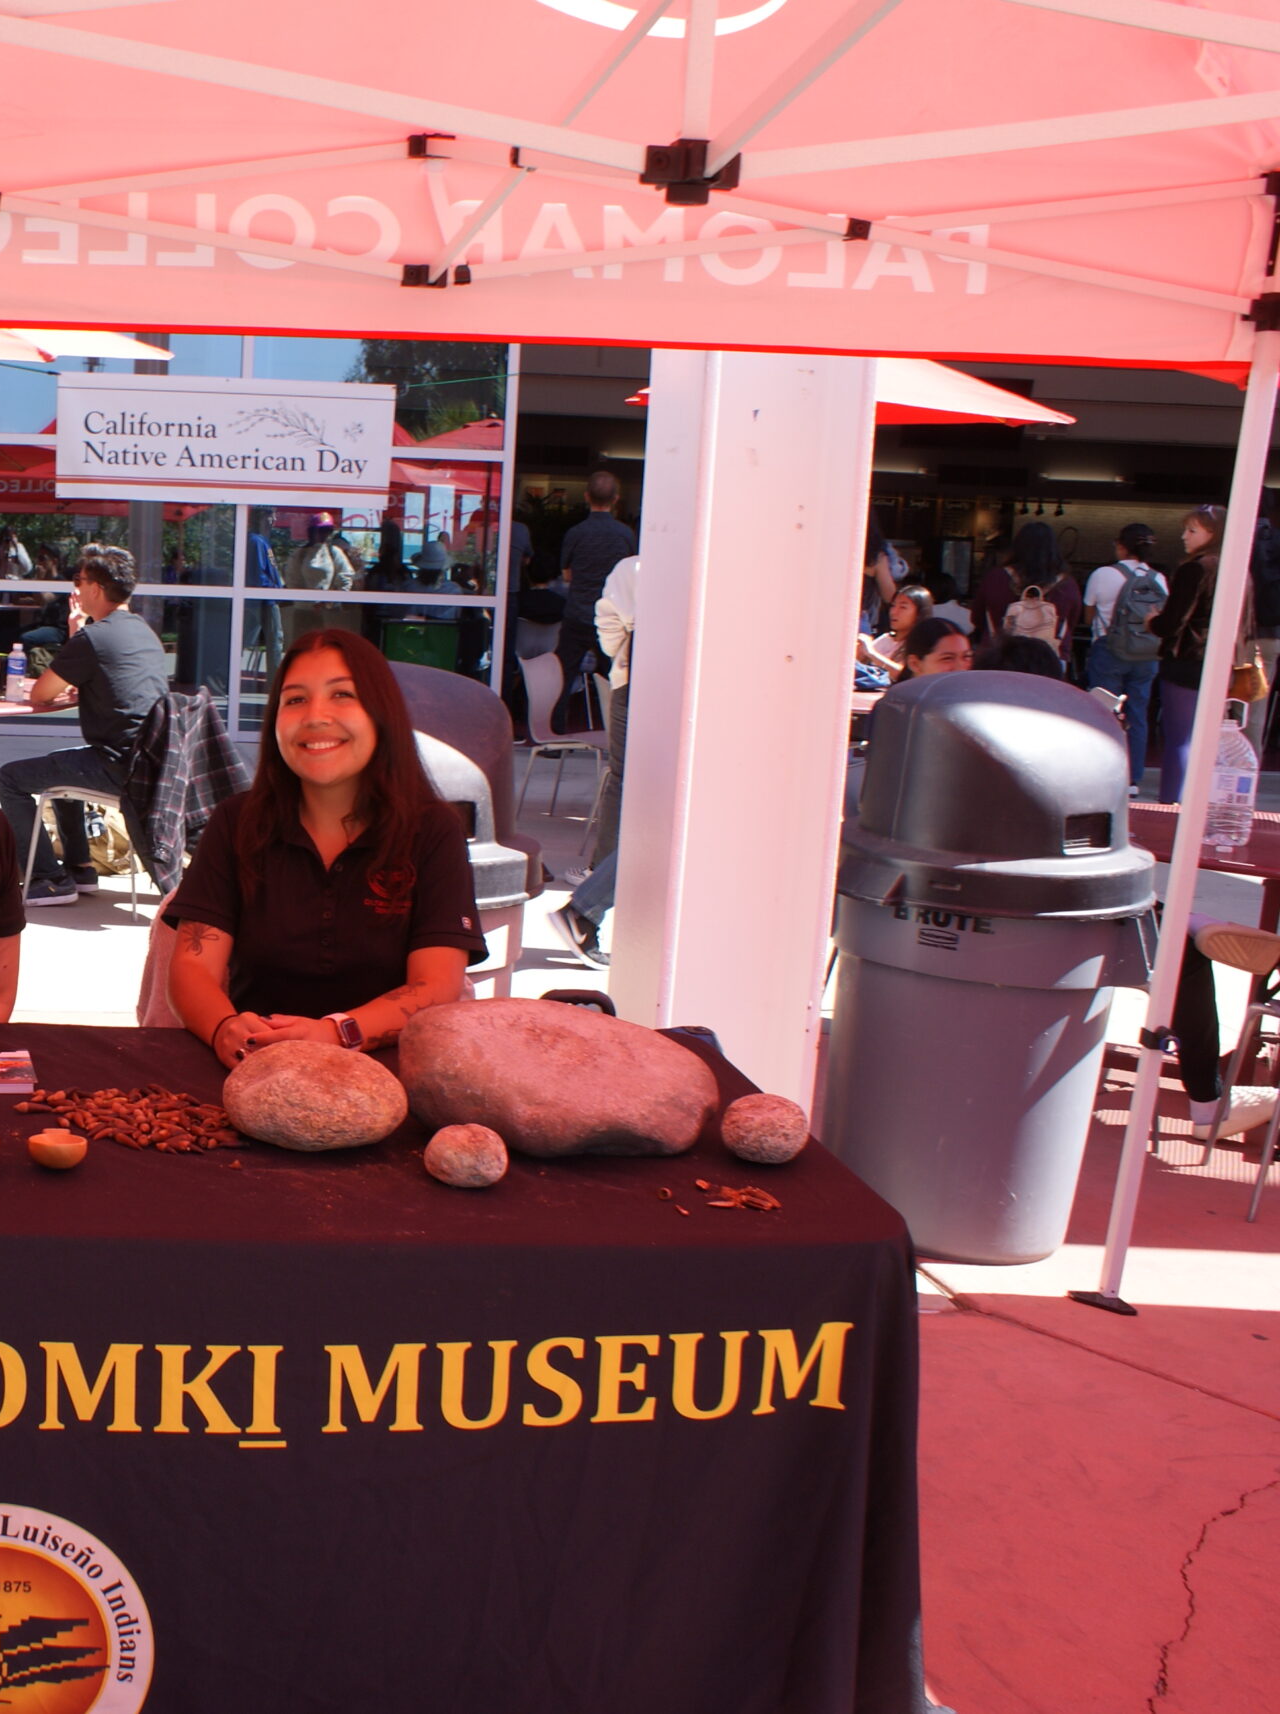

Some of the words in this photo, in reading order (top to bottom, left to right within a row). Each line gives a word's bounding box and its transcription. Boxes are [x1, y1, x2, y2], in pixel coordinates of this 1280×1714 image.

[82, 440, 168, 467] Native
[175, 444, 306, 472] American
[316, 449, 369, 479] Day
[83, 410, 218, 439] California
[321, 1321, 854, 1432] MUSEUM
[0, 1514, 104, 1580] Luiseño
[101, 1579, 141, 1683] Indians
